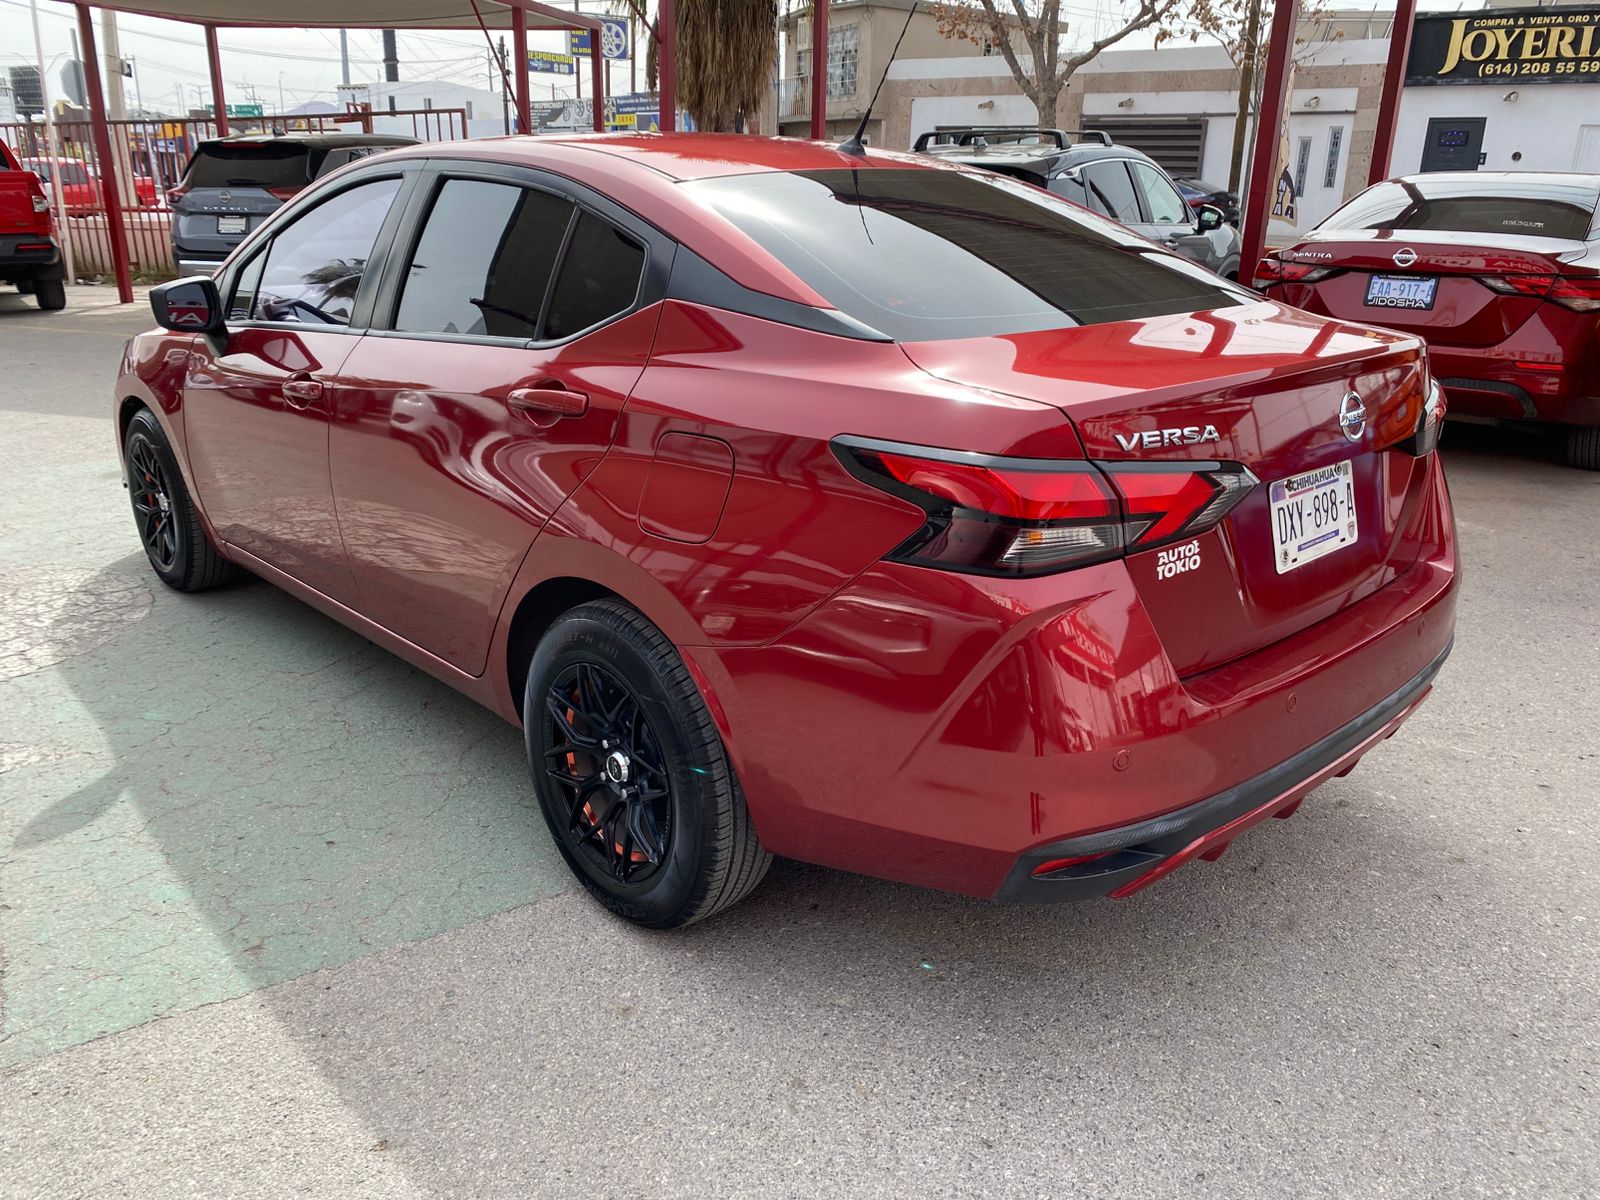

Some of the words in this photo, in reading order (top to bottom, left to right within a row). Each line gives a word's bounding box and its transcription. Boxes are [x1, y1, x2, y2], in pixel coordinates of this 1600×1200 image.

[1474, 19, 1514, 27] COMPRA
[1517, 17, 1525, 25] &
[1530, 15, 1564, 25] VENTA
[1567, 14, 1590, 23] ORO
[1438, 18, 1600, 75] JOYERI
[1478, 63, 1518, 77] (614)
[1521, 62, 1550, 74] 208
[1555, 62, 1575, 73] 55
[1579, 61, 1600, 73] 59
[1292, 251, 1332, 259] SENTRA
[1370, 281, 1433, 299] EAA-917-A
[1368, 296, 1426, 308] JIDOSHA
[1114, 424, 1221, 452] VERSA
[1291, 467, 1335, 492] CHIHUAHUA
[1277, 482, 1355, 546] DXY-898-A
[1157, 555, 1201, 581] TOKIO
